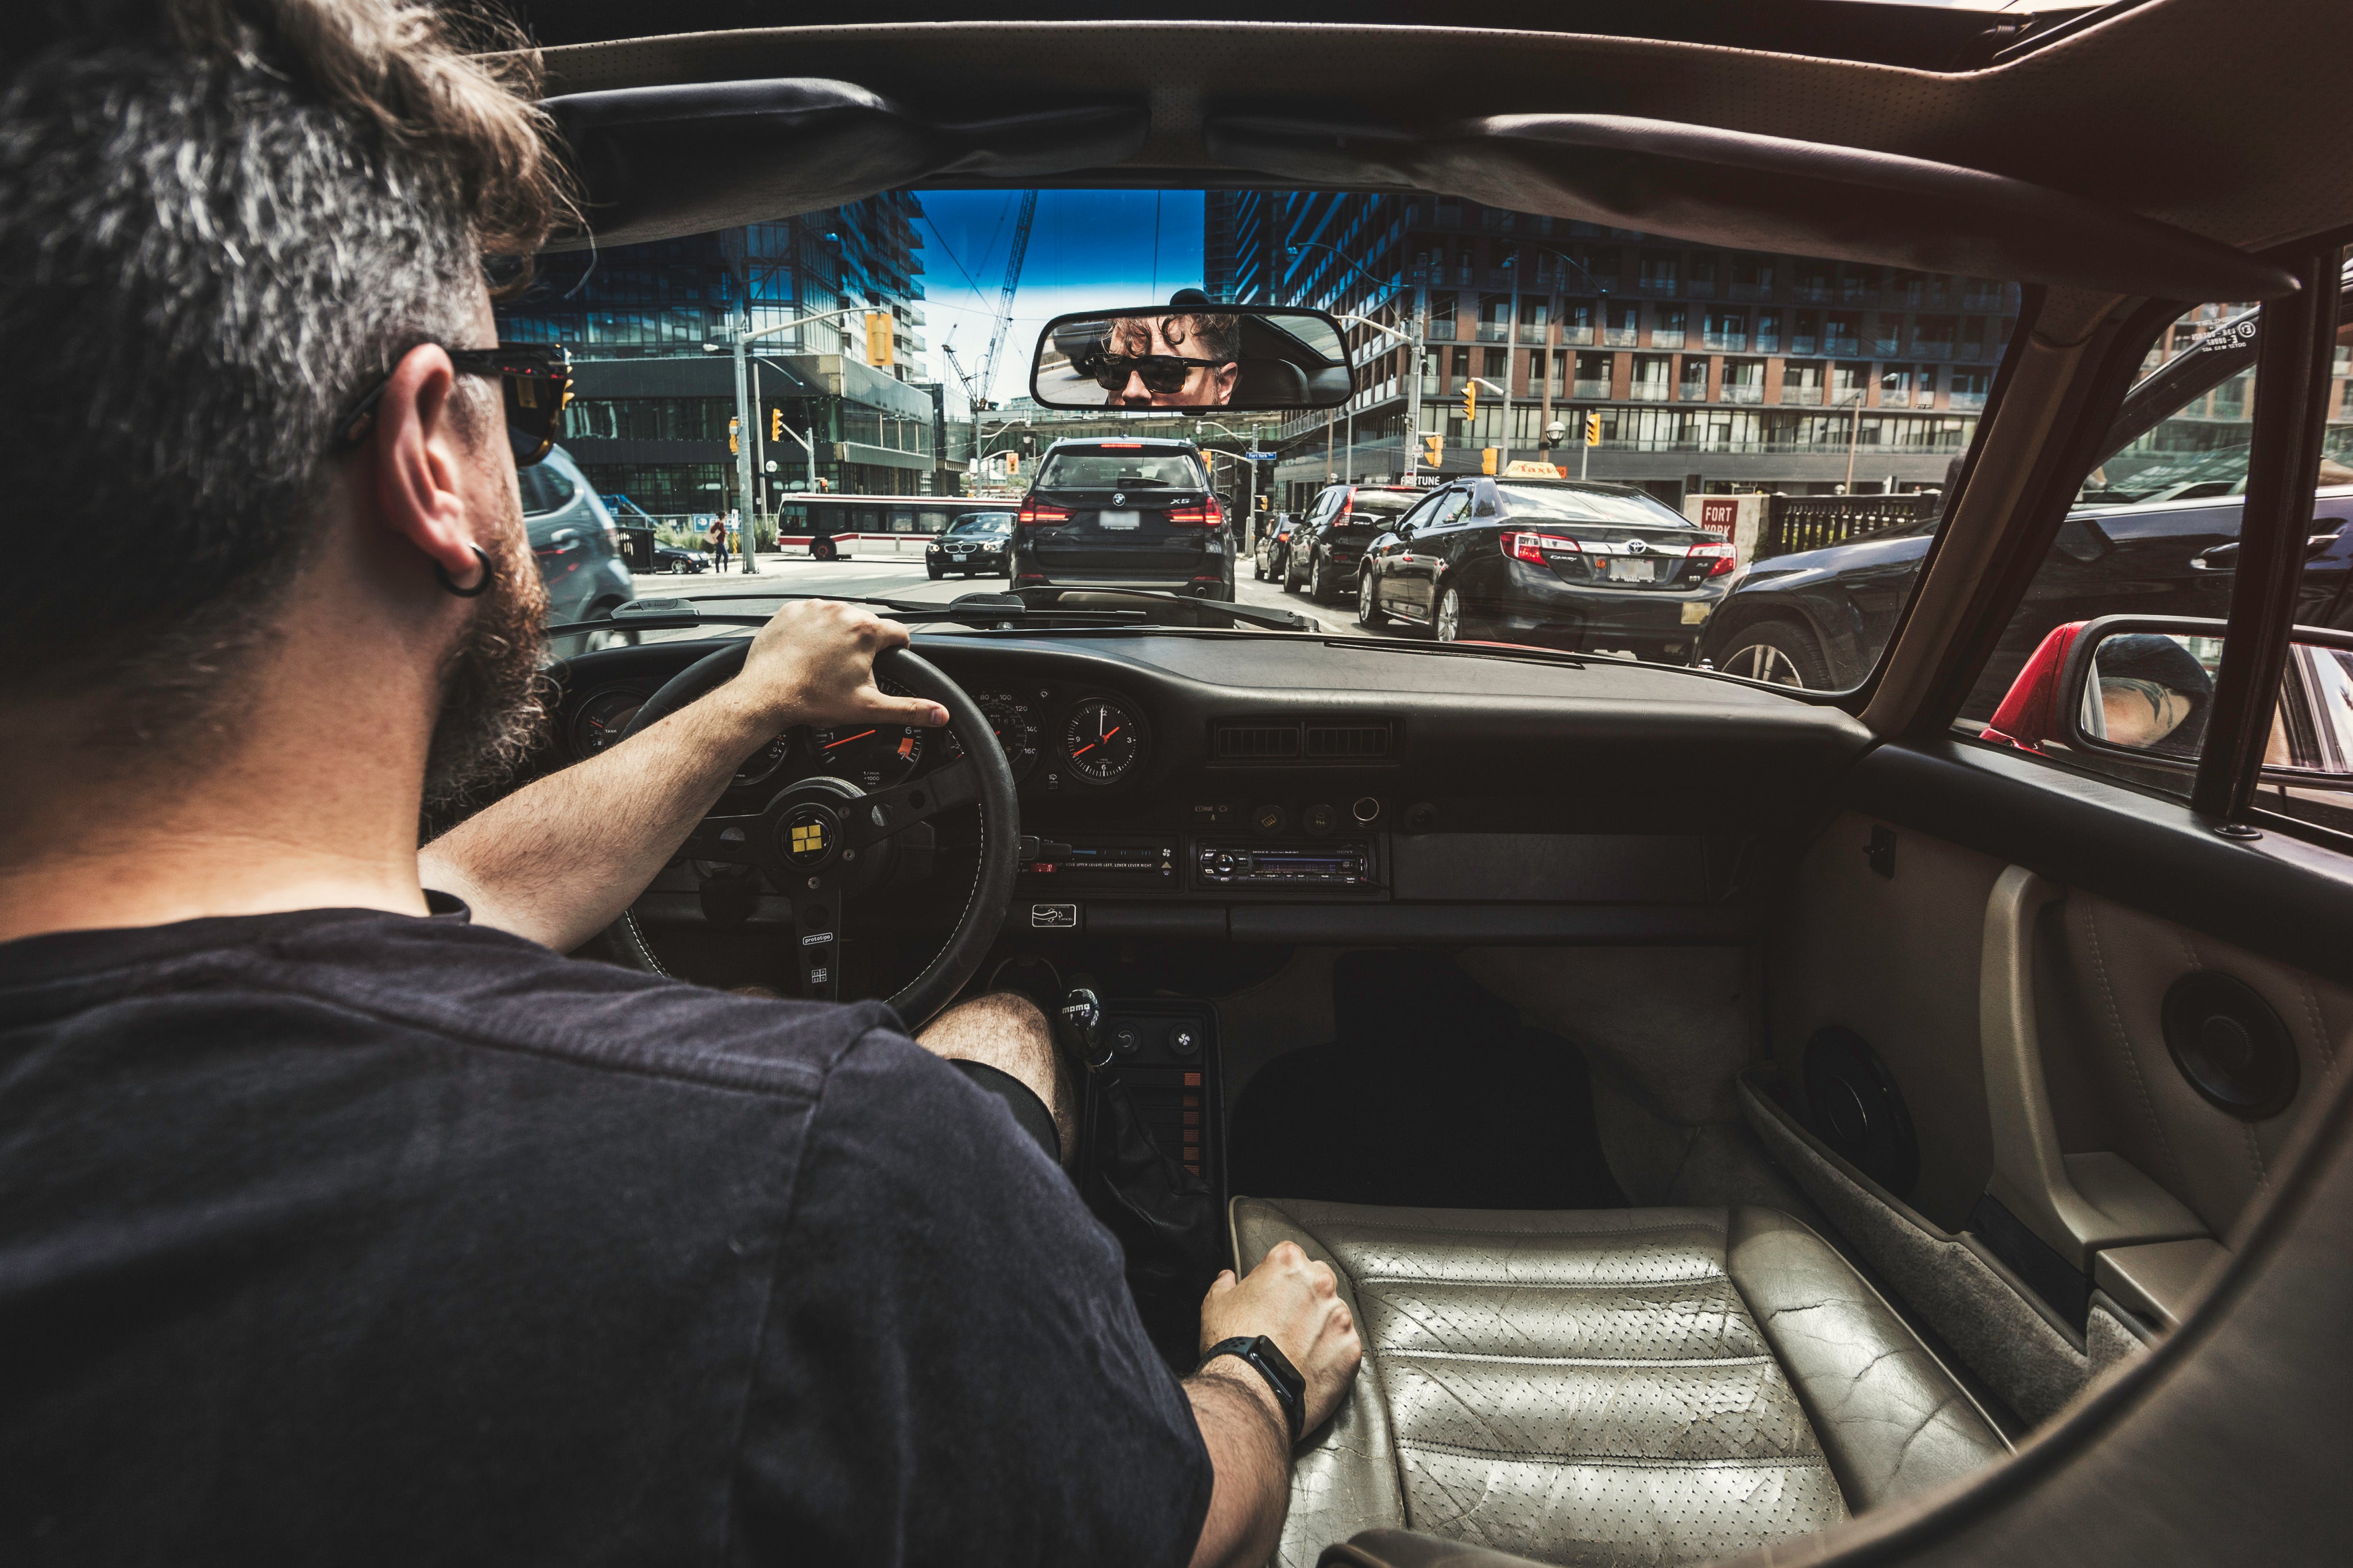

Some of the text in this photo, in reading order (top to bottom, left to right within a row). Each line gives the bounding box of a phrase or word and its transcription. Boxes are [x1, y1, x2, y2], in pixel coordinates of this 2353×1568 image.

[1518, 465, 1551, 474] Taxi
[1401, 476, 1440, 486] FTUNE
[1705, 507, 1732, 522] FORT
[900, 752, 907, 760] 7
[805, 934, 831, 944] prototipo
[1062, 1003, 1090, 1014] momo
